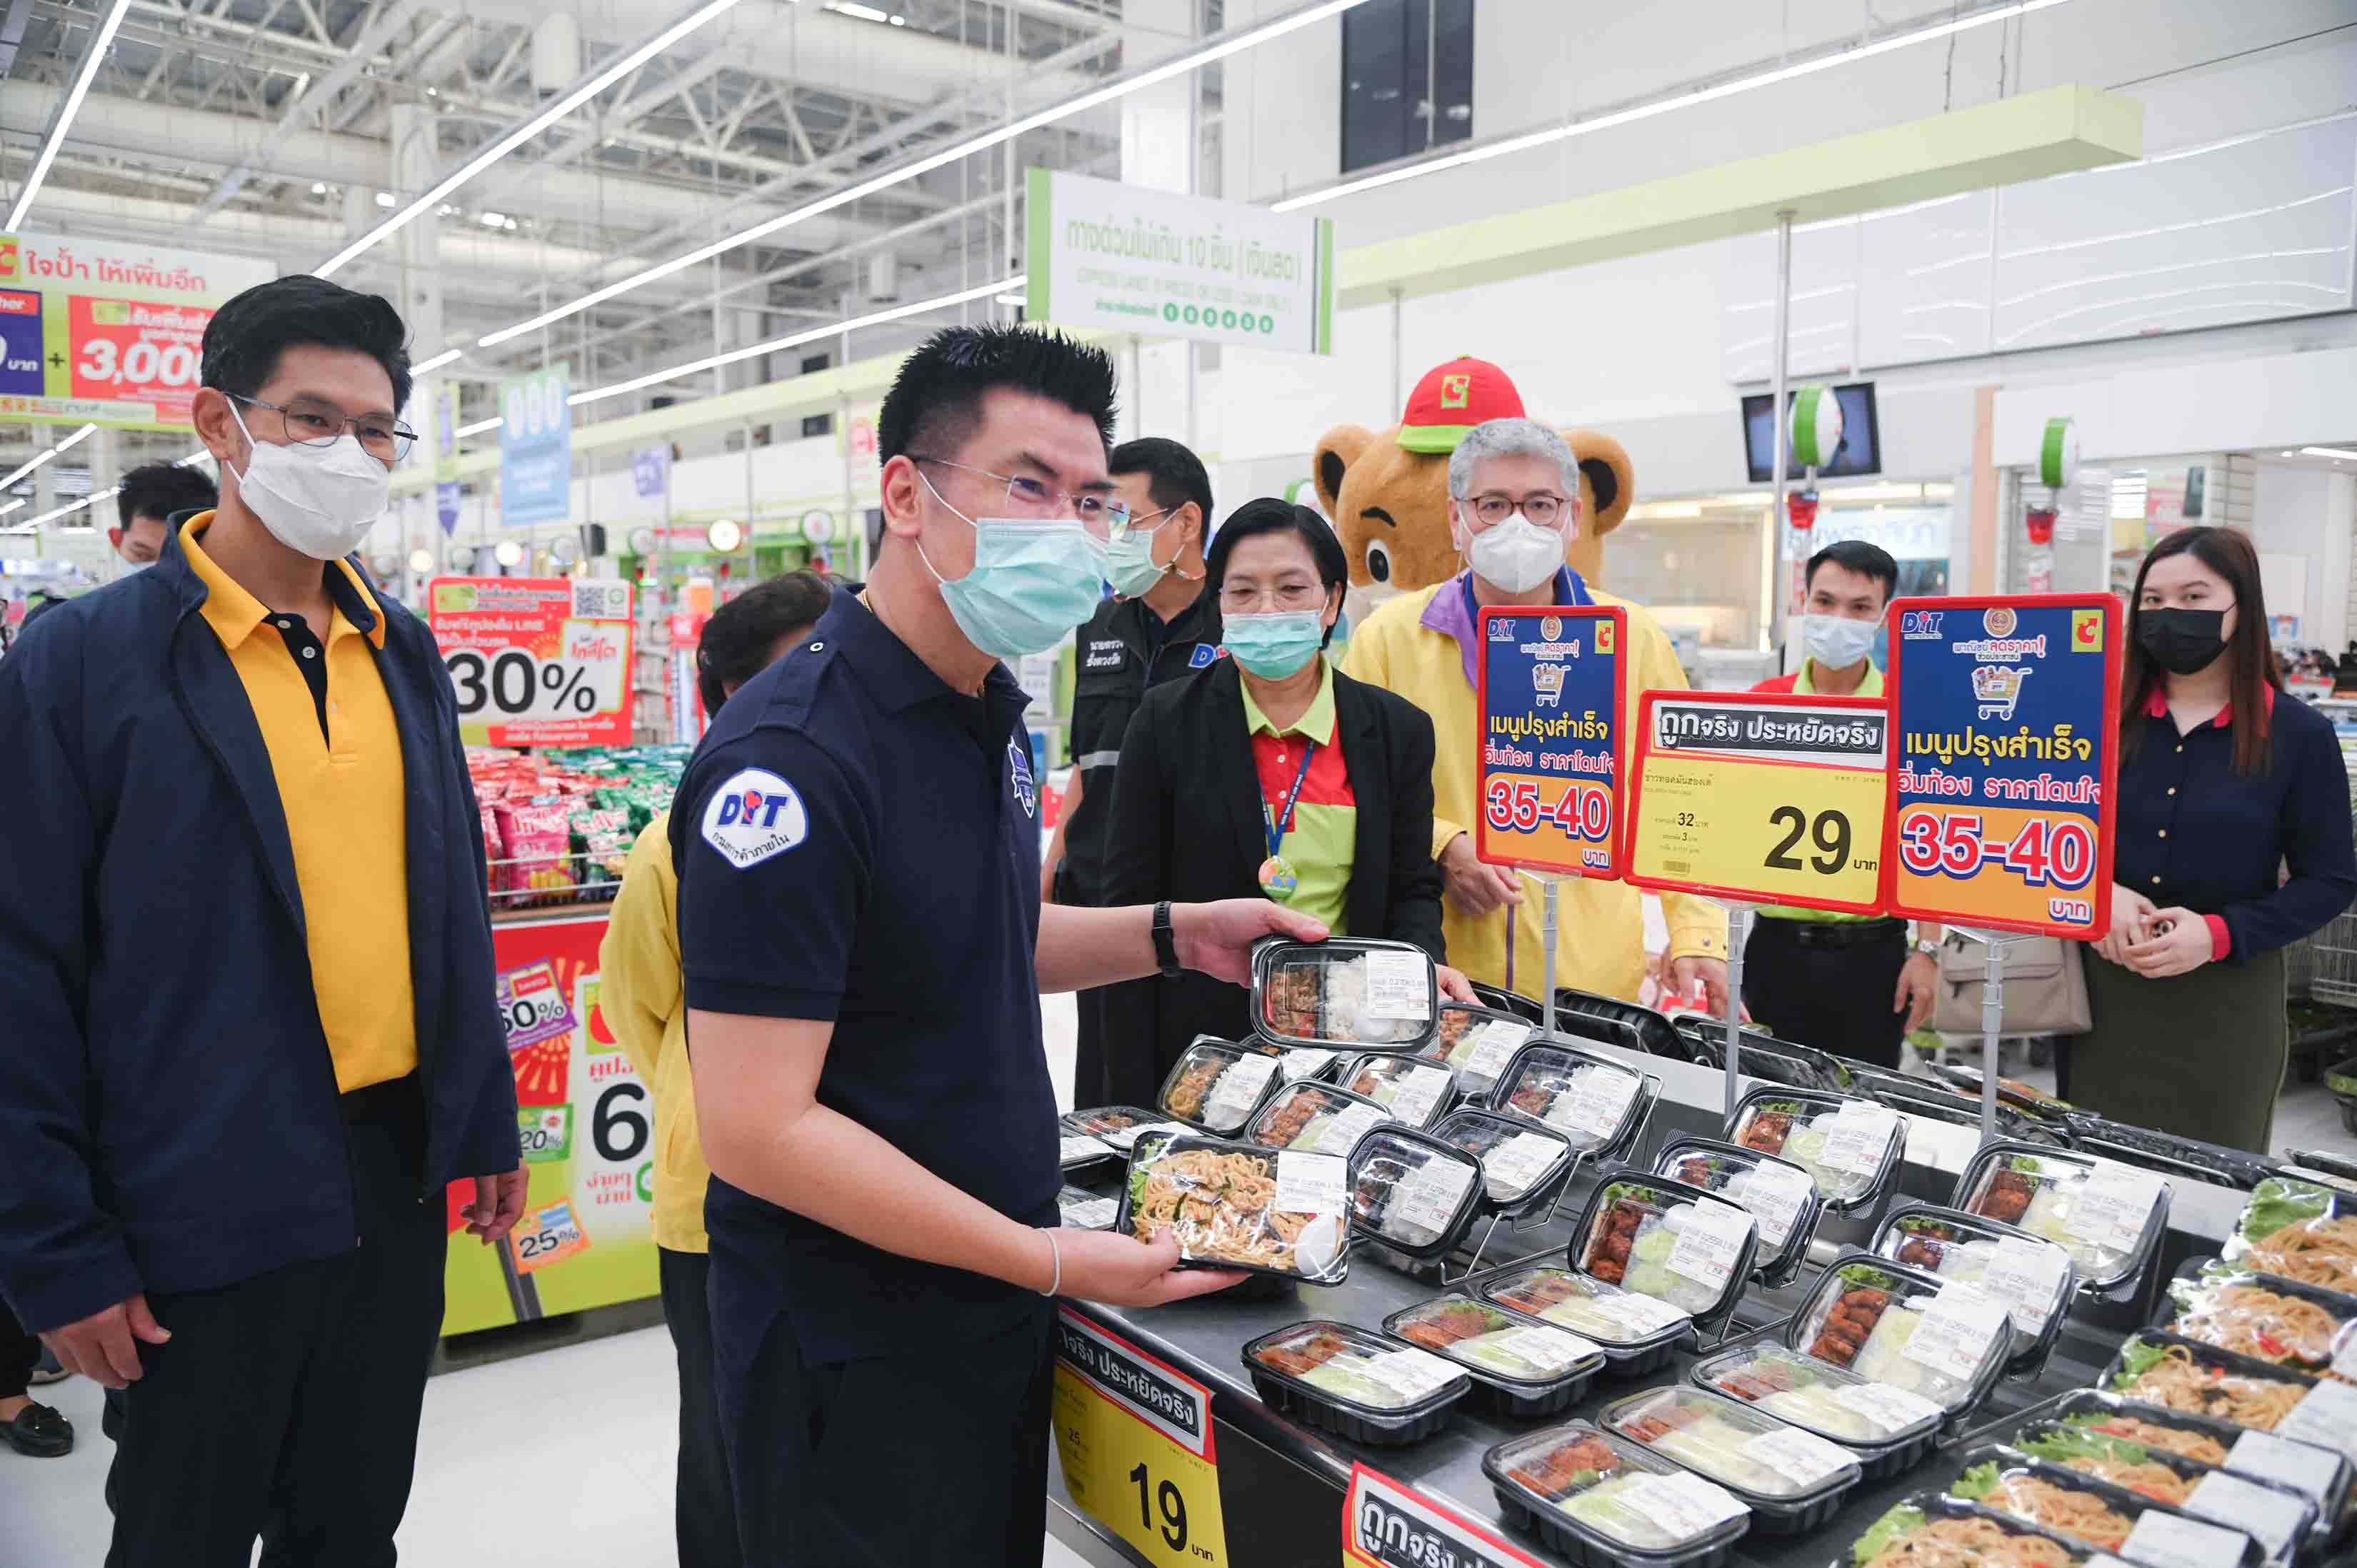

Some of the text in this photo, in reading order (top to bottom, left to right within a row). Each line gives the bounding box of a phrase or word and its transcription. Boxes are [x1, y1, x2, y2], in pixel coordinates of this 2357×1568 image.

[8, 359, 39, 371] บาท
[78, 338, 203, 386] 3,00
[1902, 611, 1943, 633] DIT
[447, 652, 596, 714] 30%
[1491, 710, 1608, 743] เมนูปรุงสำเร็จ
[1661, 712, 1881, 748] ถูกจริง ประหยัดจริง
[1486, 738, 1533, 768] อิ่มท้อง
[1906, 724, 2092, 766] เมนูปรุงสำเร็จ
[1898, 760, 2102, 804] อิ่มท้อง ราคาโดนใจ
[716, 789, 789, 828] DIT
[1486, 779, 1611, 842] 35-40
[1678, 813, 1694, 826] 32
[713, 832, 790, 863] กรมการค้าภายใน
[1681, 833, 1688, 842] 3
[1764, 806, 1851, 875] 29
[1901, 811, 2096, 890] 35-40
[1581, 848, 1609, 868] บาท
[1853, 859, 1878, 871] บาท
[2048, 898, 2092, 924] บาท
[519, 1227, 580, 1259] 25%
[1099, 1352, 1194, 1426] ประหยัดจริง
[1130, 1462, 1187, 1552] 19
[1191, 1543, 1214, 1562] บาท
